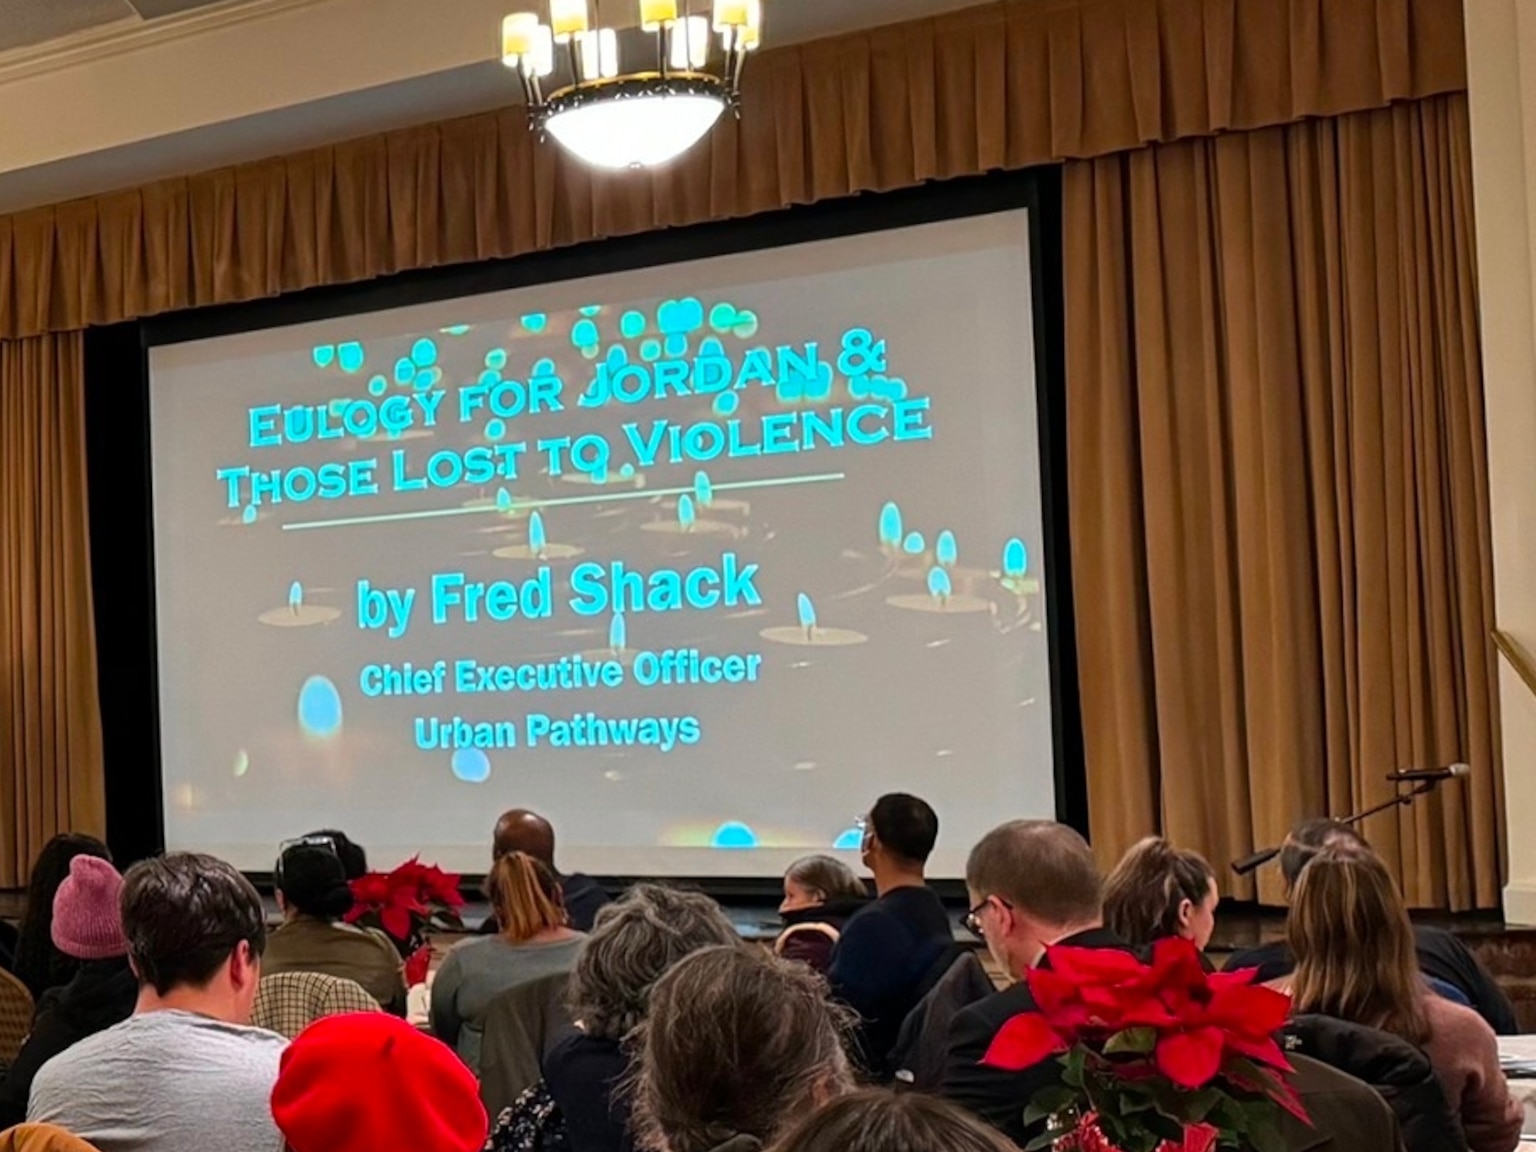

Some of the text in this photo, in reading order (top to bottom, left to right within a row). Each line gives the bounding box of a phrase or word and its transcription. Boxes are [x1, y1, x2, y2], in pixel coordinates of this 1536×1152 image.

[837, 328, 887, 377] &
[357, 552, 762, 638] by Fred Shack
[360, 648, 762, 696] Chief Executive Officer
[415, 711, 701, 752] Urban Pathways
